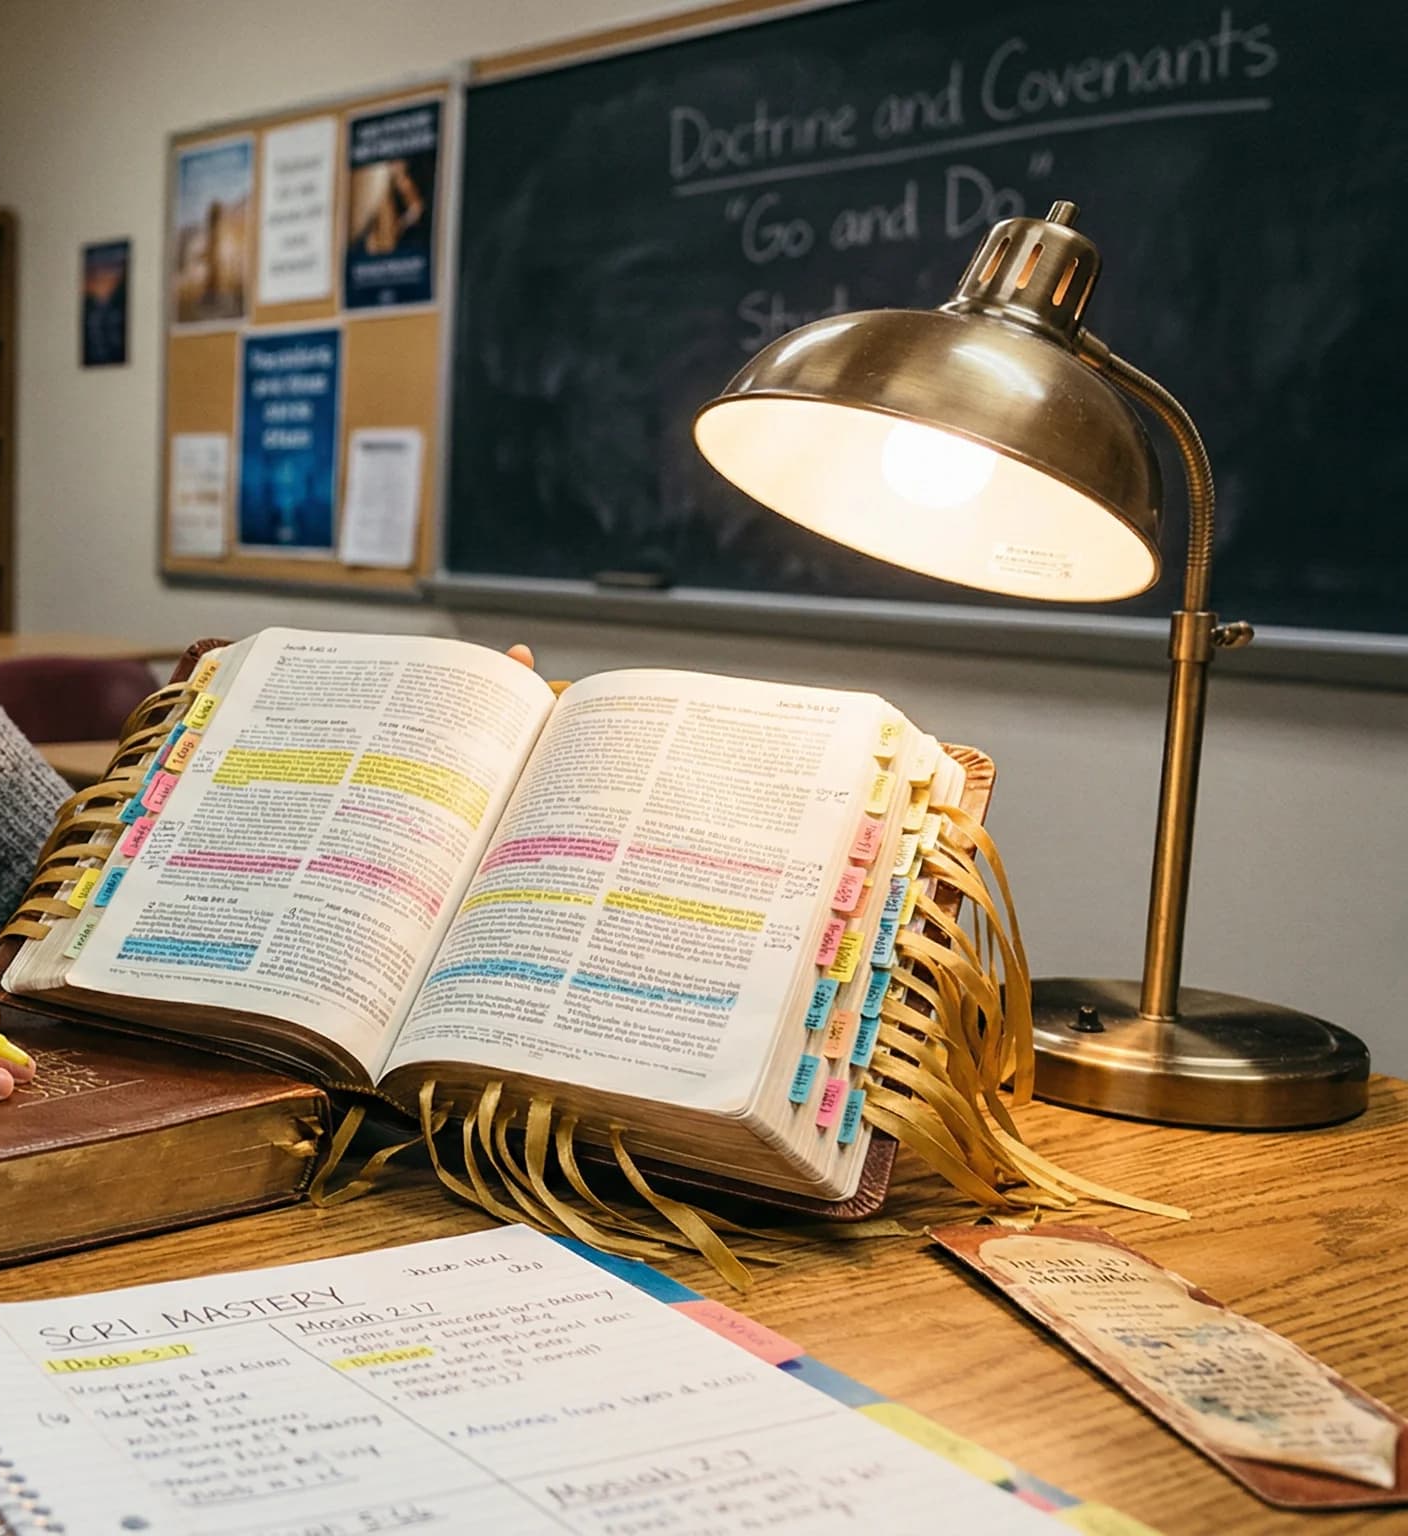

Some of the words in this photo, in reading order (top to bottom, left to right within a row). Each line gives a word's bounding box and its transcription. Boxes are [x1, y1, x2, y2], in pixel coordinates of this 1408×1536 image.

[669, 99, 857, 178] Doctrine
[872, 58, 963, 140] and
[981, 8, 1279, 121] Covenants
[831, 179, 919, 248] and
[39, 1318, 151, 1347] SCRI.
[161, 1286, 346, 1328] MASTERY
[295, 1311, 383, 1335] Mosiah
[385, 1301, 436, 1319] 2:17
